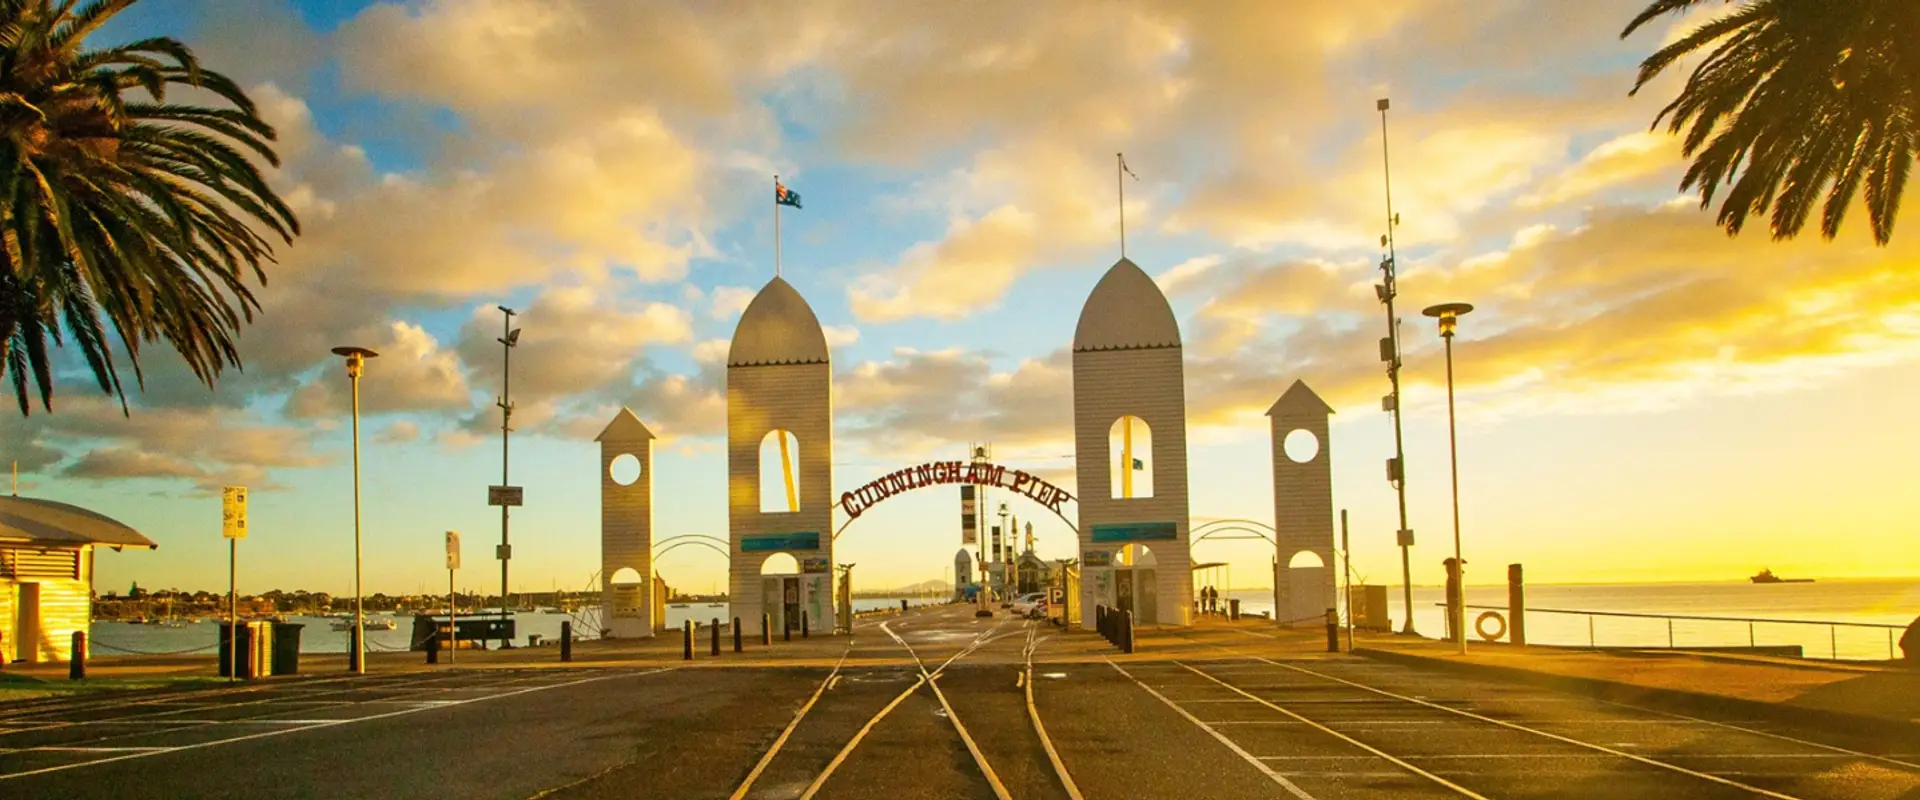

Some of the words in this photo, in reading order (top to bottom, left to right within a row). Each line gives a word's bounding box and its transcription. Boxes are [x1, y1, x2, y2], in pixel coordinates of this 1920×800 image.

[841, 461, 1006, 519] CUNNINGHAM
[1009, 470, 1070, 516] PIER
[1053, 589, 1064, 603] P
